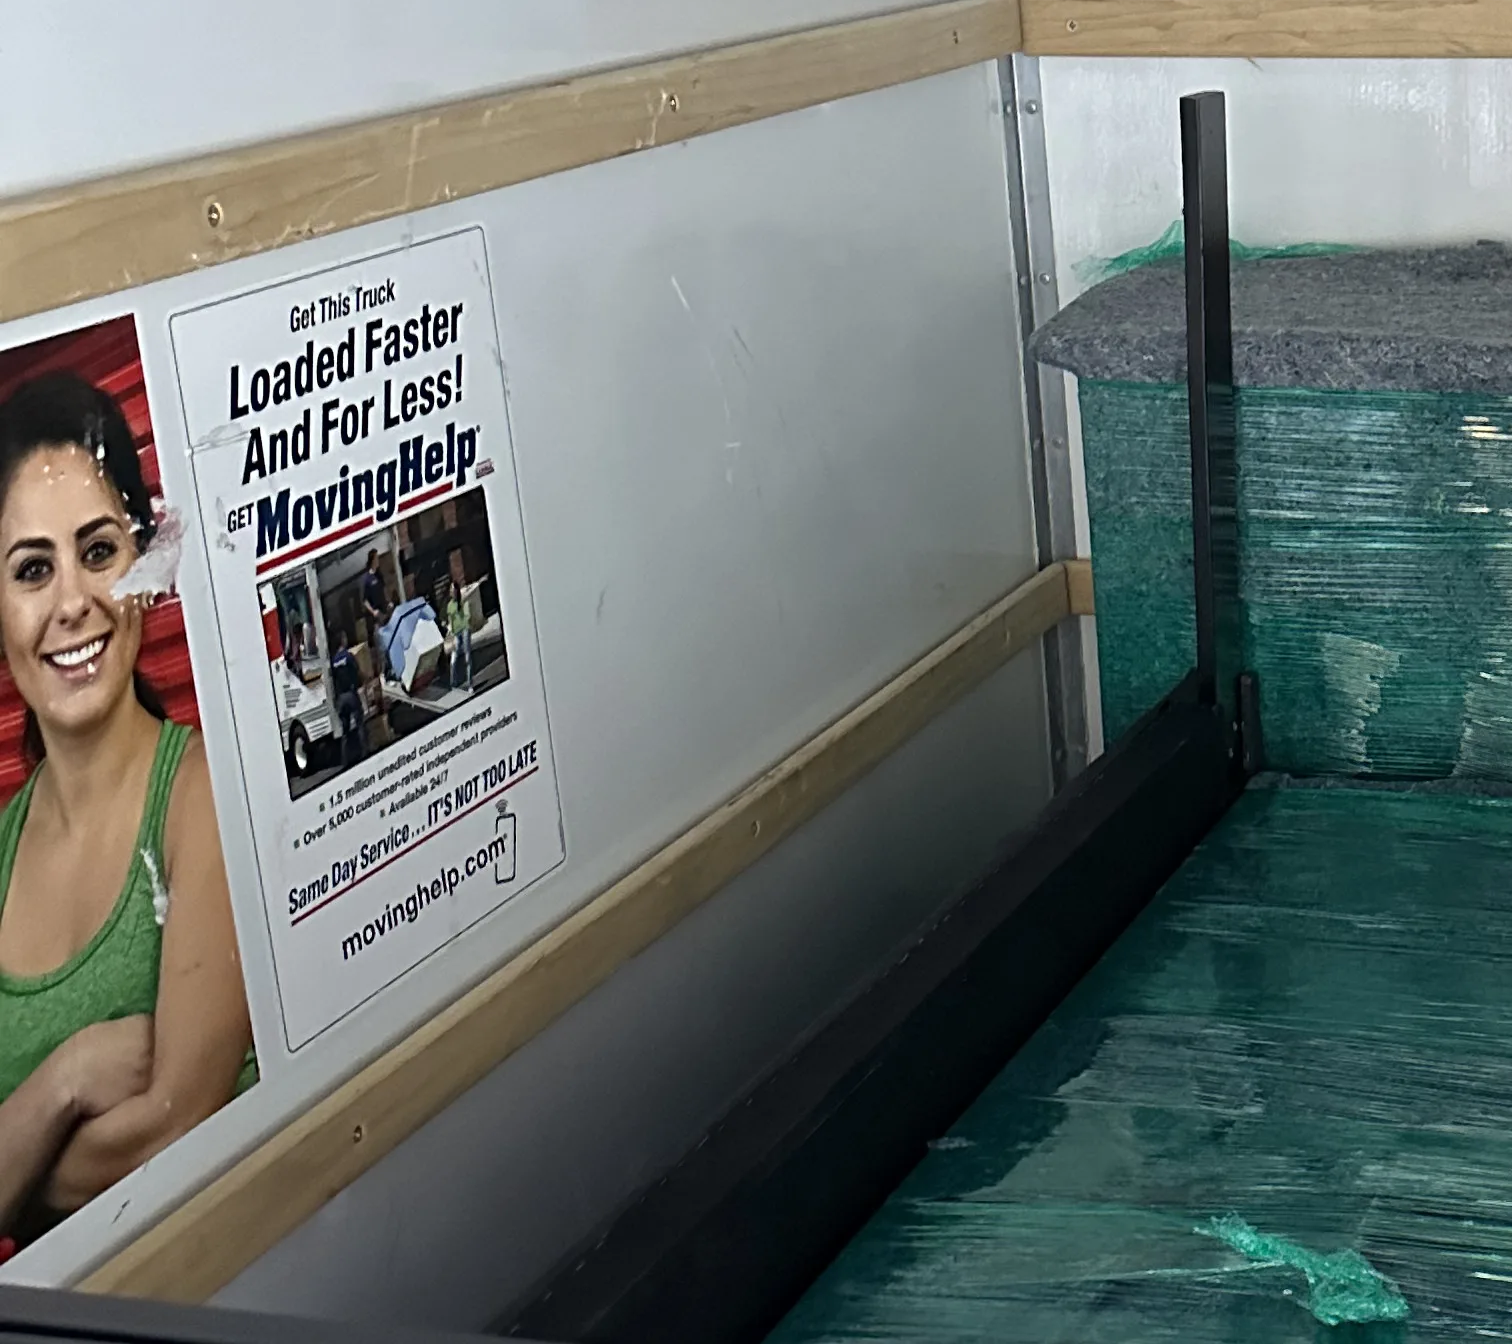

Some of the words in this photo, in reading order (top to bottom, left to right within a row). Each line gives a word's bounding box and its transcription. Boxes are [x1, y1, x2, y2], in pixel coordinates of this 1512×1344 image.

[230, 327, 356, 421] Loaded
[365, 302, 464, 374] Faster
[290, 301, 316, 333] Get
[319, 292, 351, 324] This
[355, 277, 396, 313] Truck
[241, 407, 311, 486] And
[321, 395, 375, 455] For
[383, 353, 463, 431] Less!
[227, 501, 255, 534] GET
[303, 823, 327, 846] Over
[328, 805, 355, 831] 5,000
[355, 762, 425, 815] customer-rated
[426, 732, 480, 773] independent
[480, 711, 518, 744] providers
[328, 789, 344, 809] 1.5
[345, 774, 376, 801] million
[377, 746, 417, 781] unedited
[418, 724, 460, 757] customer
[460, 706, 492, 732] reviews
[388, 783, 429, 816] Available
[429, 768, 450, 792] 24/7
[288, 873, 329, 915] Same
[331, 856, 358, 885] Day
[427, 791, 454, 828] IT'S
[454, 773, 481, 811] NOT
[482, 758, 507, 793] TOO
[508, 739, 537, 777] LATE
[340, 836, 508, 961] movinghelp.com
